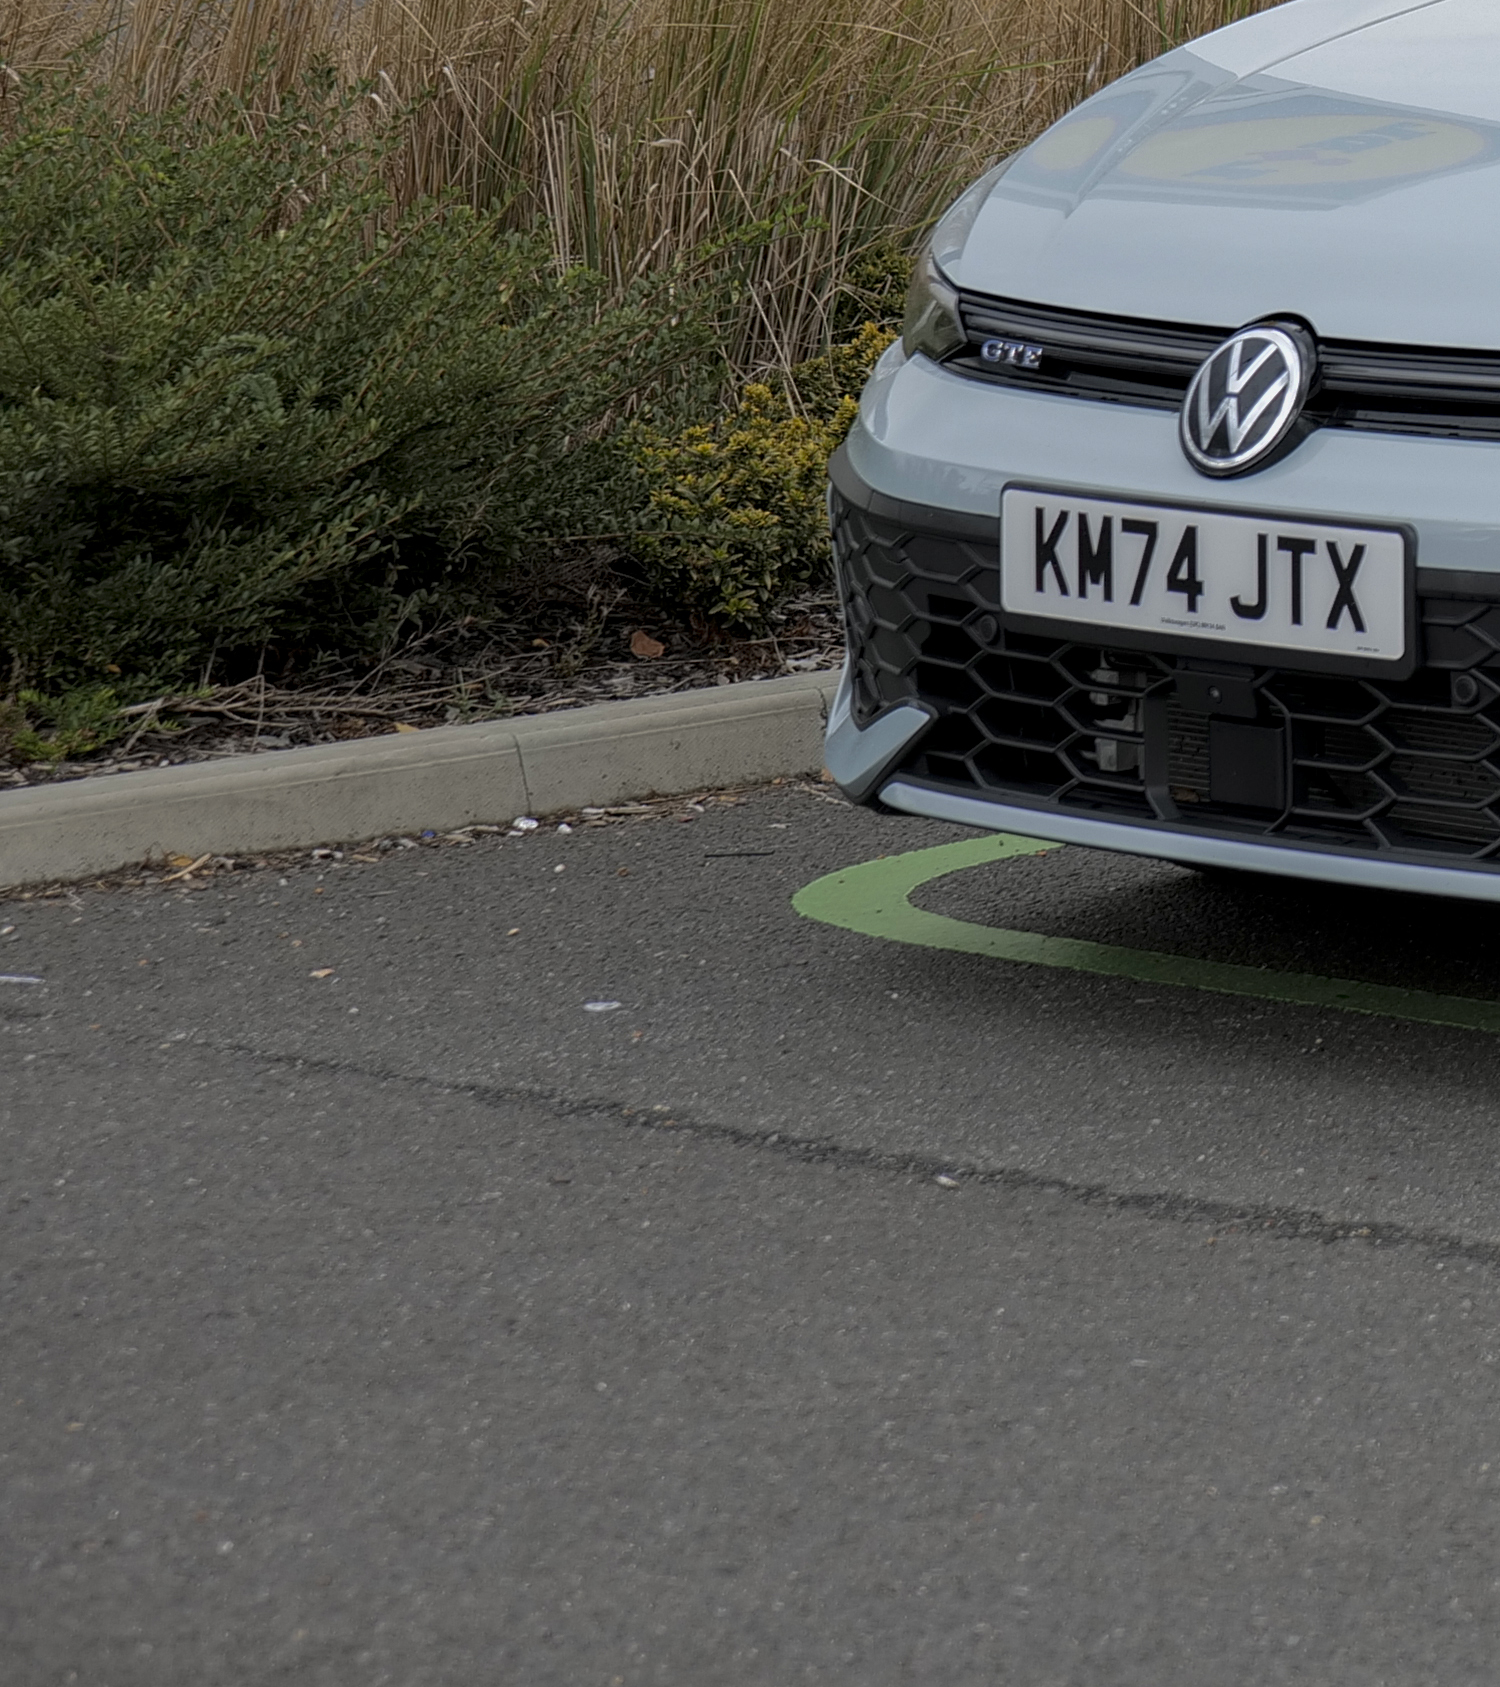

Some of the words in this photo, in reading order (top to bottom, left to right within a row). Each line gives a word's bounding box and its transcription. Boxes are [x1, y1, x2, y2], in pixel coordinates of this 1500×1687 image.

[981, 339, 1043, 369] GTE
[1034, 506, 1205, 613] KM74
[1229, 533, 1368, 635] JTX
